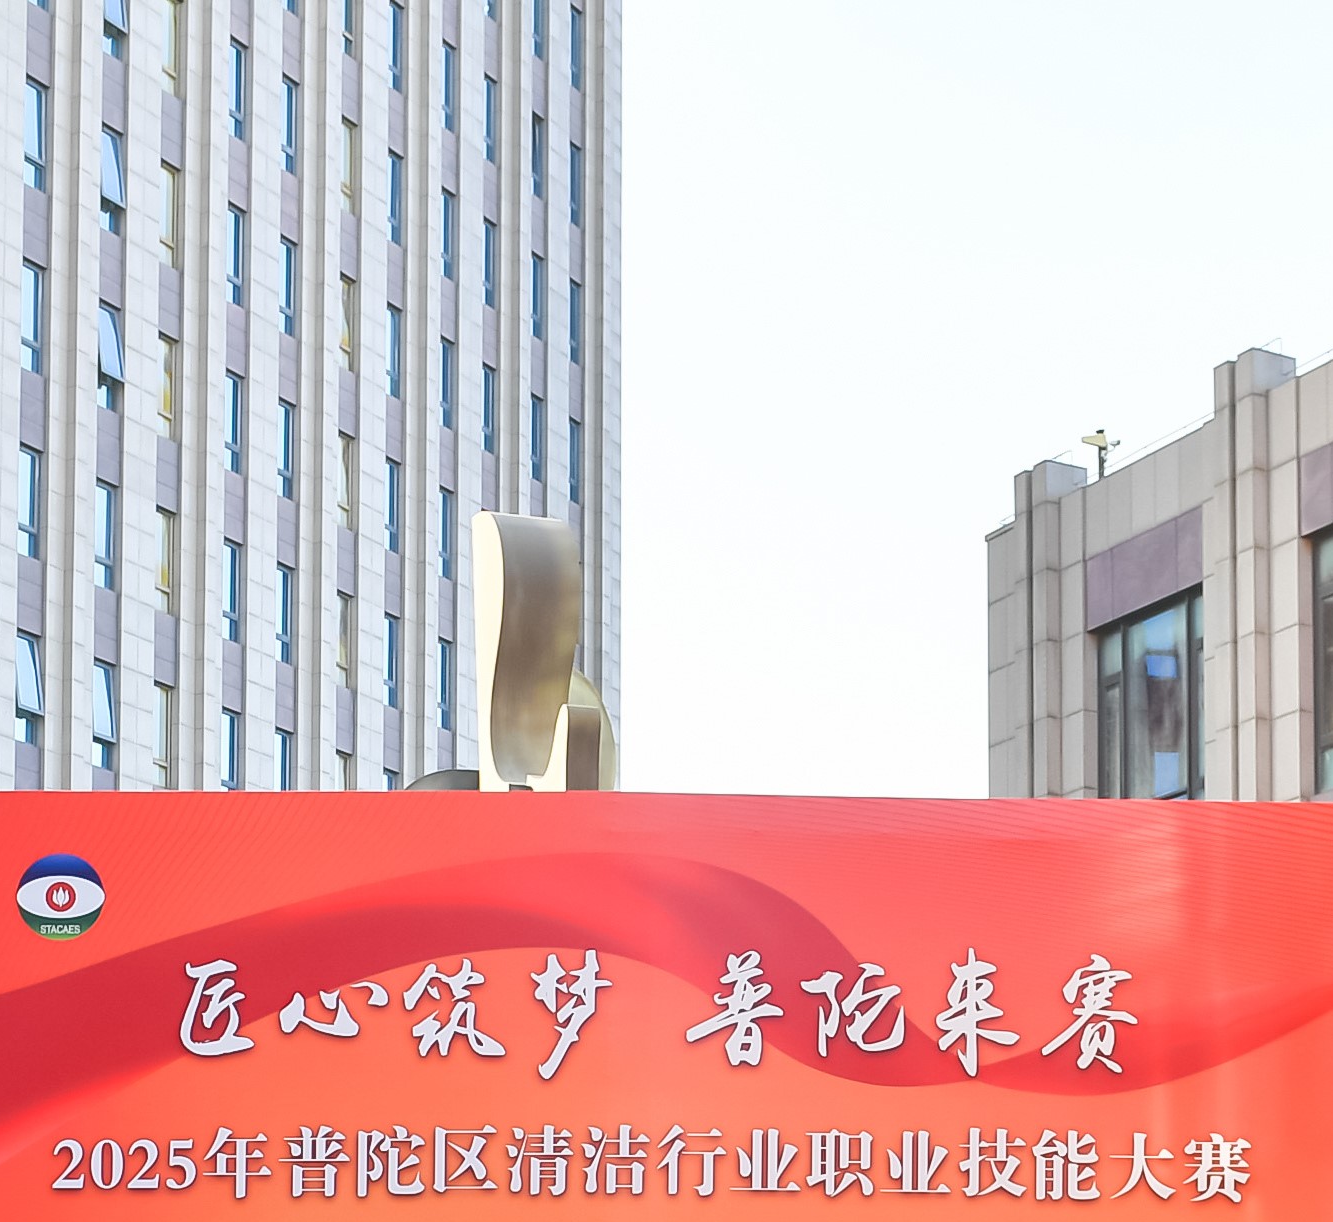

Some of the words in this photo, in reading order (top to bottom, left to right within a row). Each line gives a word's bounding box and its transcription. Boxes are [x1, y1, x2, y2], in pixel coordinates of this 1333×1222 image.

[40, 924, 81, 935] STACAES
[180, 948, 613, 1081] 匠心筑梦
[685, 946, 1139, 1078] 普陀来赛
[51, 1125, 1253, 1204] 2025年普陀区清洁行业职业技能大赛
